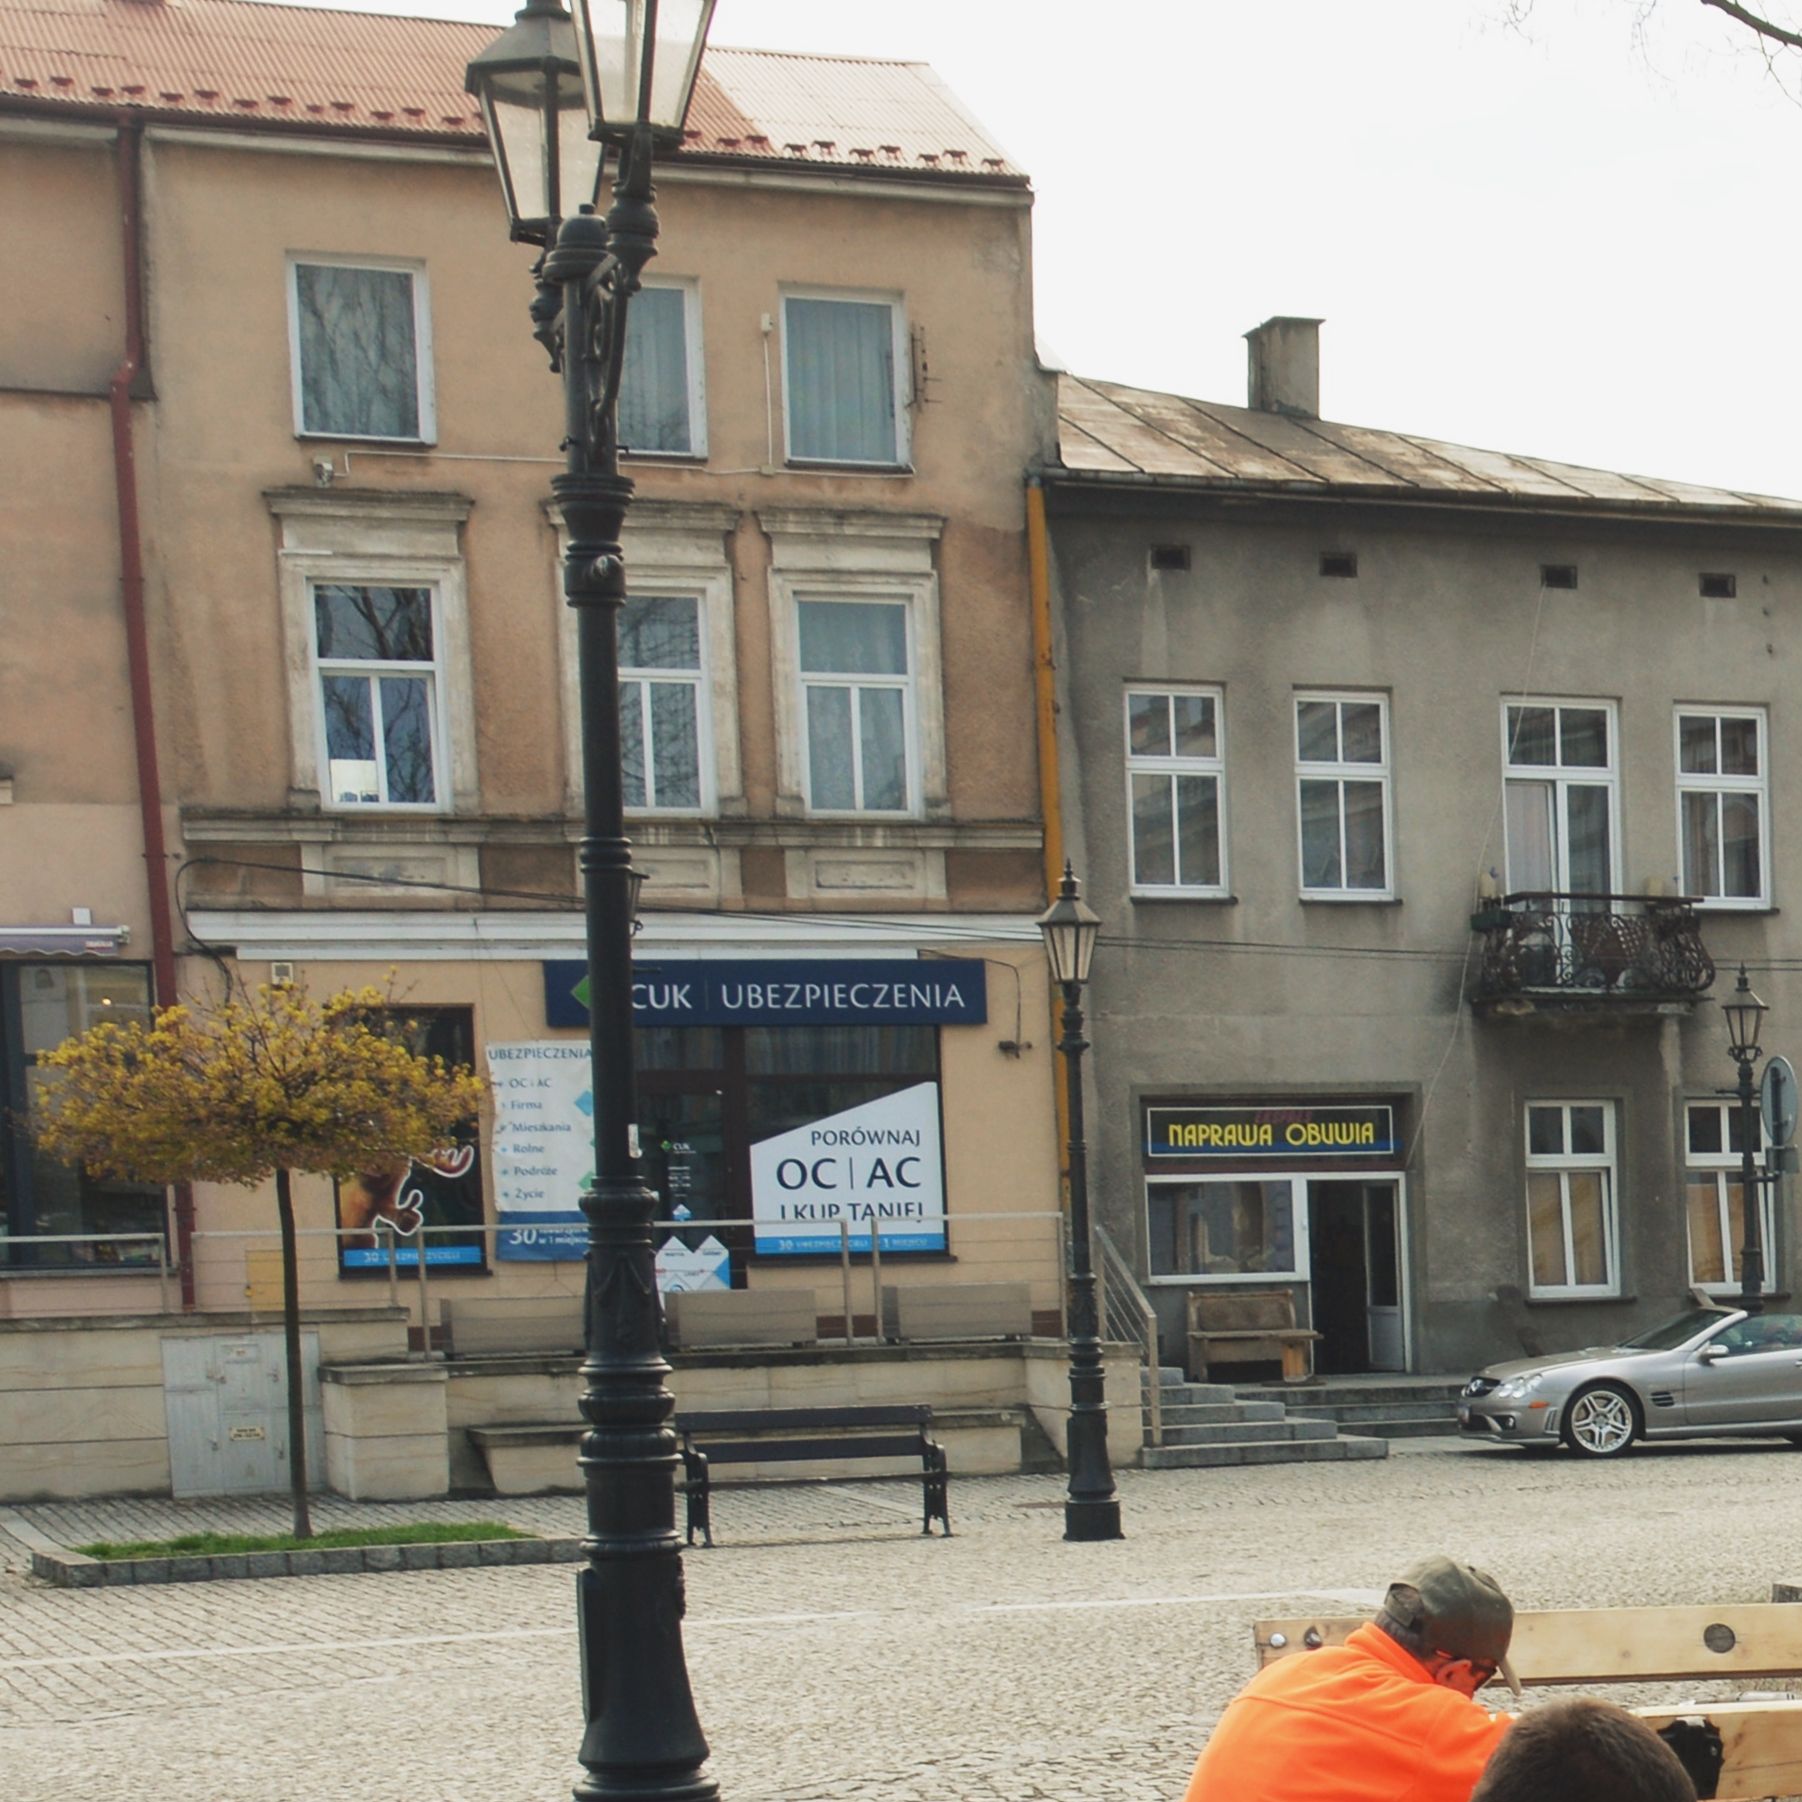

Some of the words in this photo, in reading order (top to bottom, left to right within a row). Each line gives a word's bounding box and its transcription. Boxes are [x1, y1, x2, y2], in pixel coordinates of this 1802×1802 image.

[631, 984, 692, 1009] CUK
[722, 984, 966, 1008] UBEZPIECZENIA
[488, 1047, 592, 1060] UBEZPIECZENIA
[509, 1078, 527, 1088] OC
[537, 1078, 552, 1088] AC
[512, 1121, 572, 1133] Mieszkania
[811, 1126, 920, 1146] PORÓWNAJ
[1168, 1123, 1273, 1147] NAPRAWA
[1285, 1122, 1374, 1146] OBUWIA
[512, 1143, 545, 1153] Rolne
[776, 1157, 837, 1190] OC
[866, 1156, 921, 1189] AC
[794, 1203, 841, 1220] KUP
[847, 1201, 923, 1223] TANIEJ
[509, 1228, 537, 1245] 30
